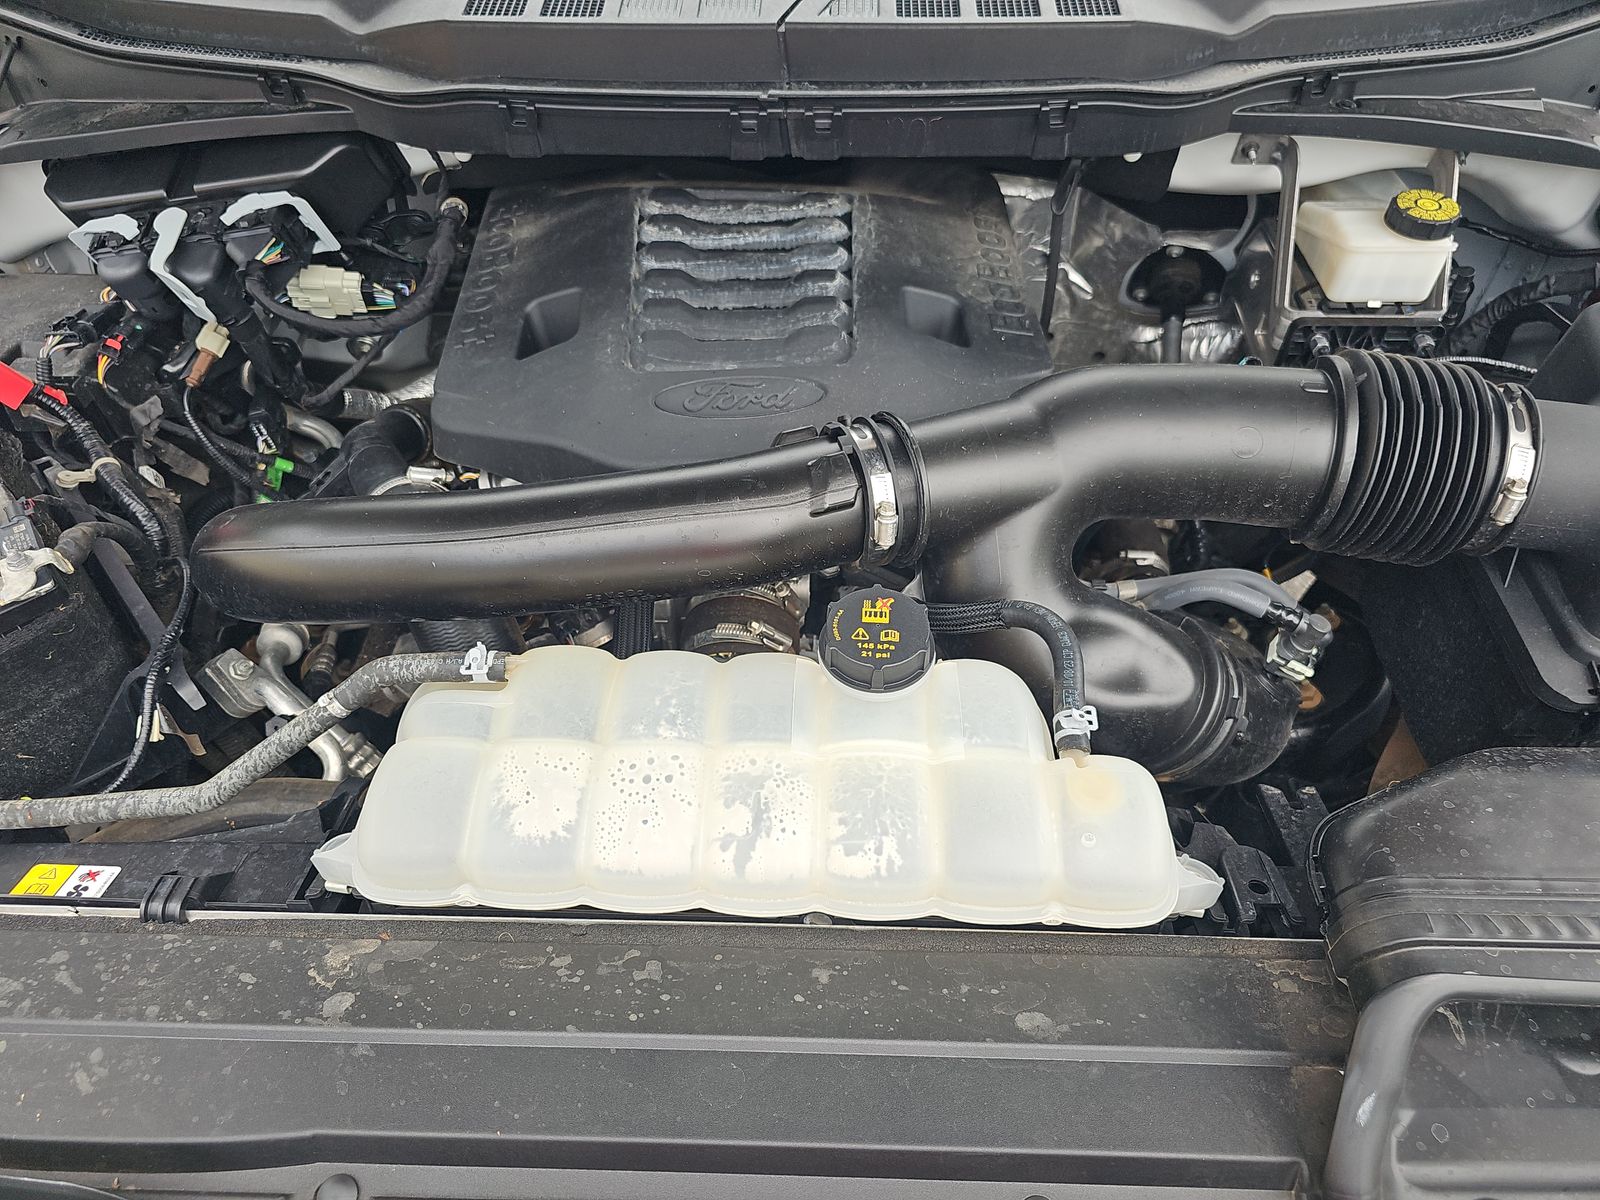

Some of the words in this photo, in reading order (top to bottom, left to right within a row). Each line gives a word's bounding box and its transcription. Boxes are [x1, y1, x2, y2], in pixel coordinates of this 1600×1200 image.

[682, 382, 800, 414] Ford
[857, 642, 875, 650] 145
[877, 643, 896, 651] kPa
[861, 650, 873, 658] 21
